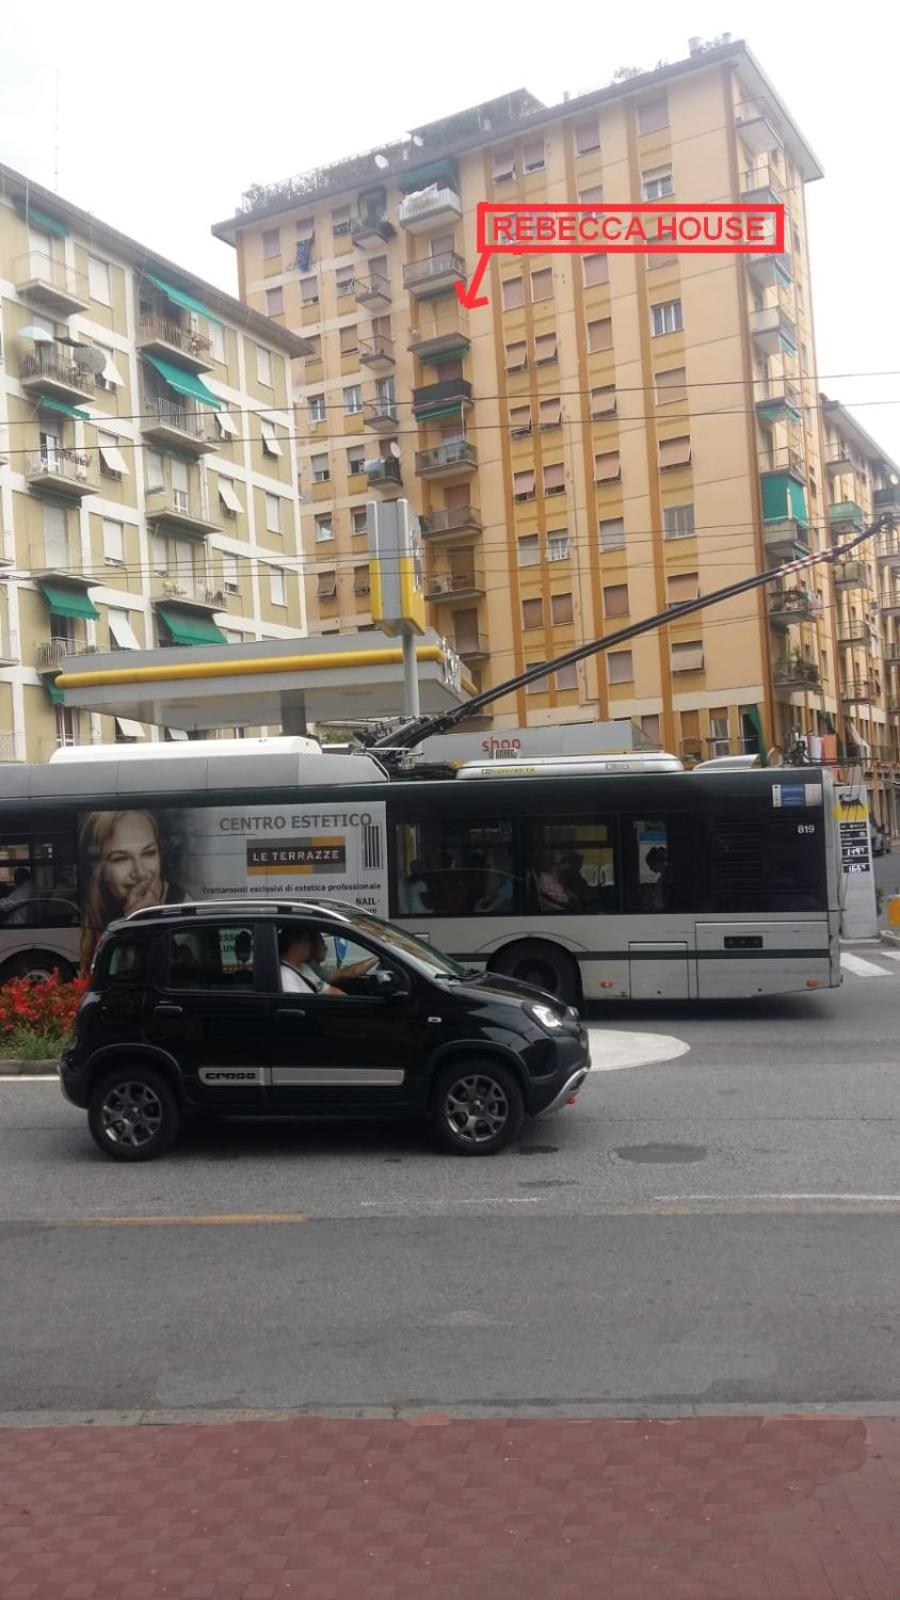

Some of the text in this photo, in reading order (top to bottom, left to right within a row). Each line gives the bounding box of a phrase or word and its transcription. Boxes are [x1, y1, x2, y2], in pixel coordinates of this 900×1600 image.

[481, 736, 521, 752] shop
[219, 812, 373, 831] CENTRO ESTETICO
[797, 824, 816, 834] 819
[252, 850, 340, 862] LE TERRAZZE
[202, 882, 381, 895] Trattamenti esclusivi di estetica professionale
[355, 897, 377, 906] NAIL
